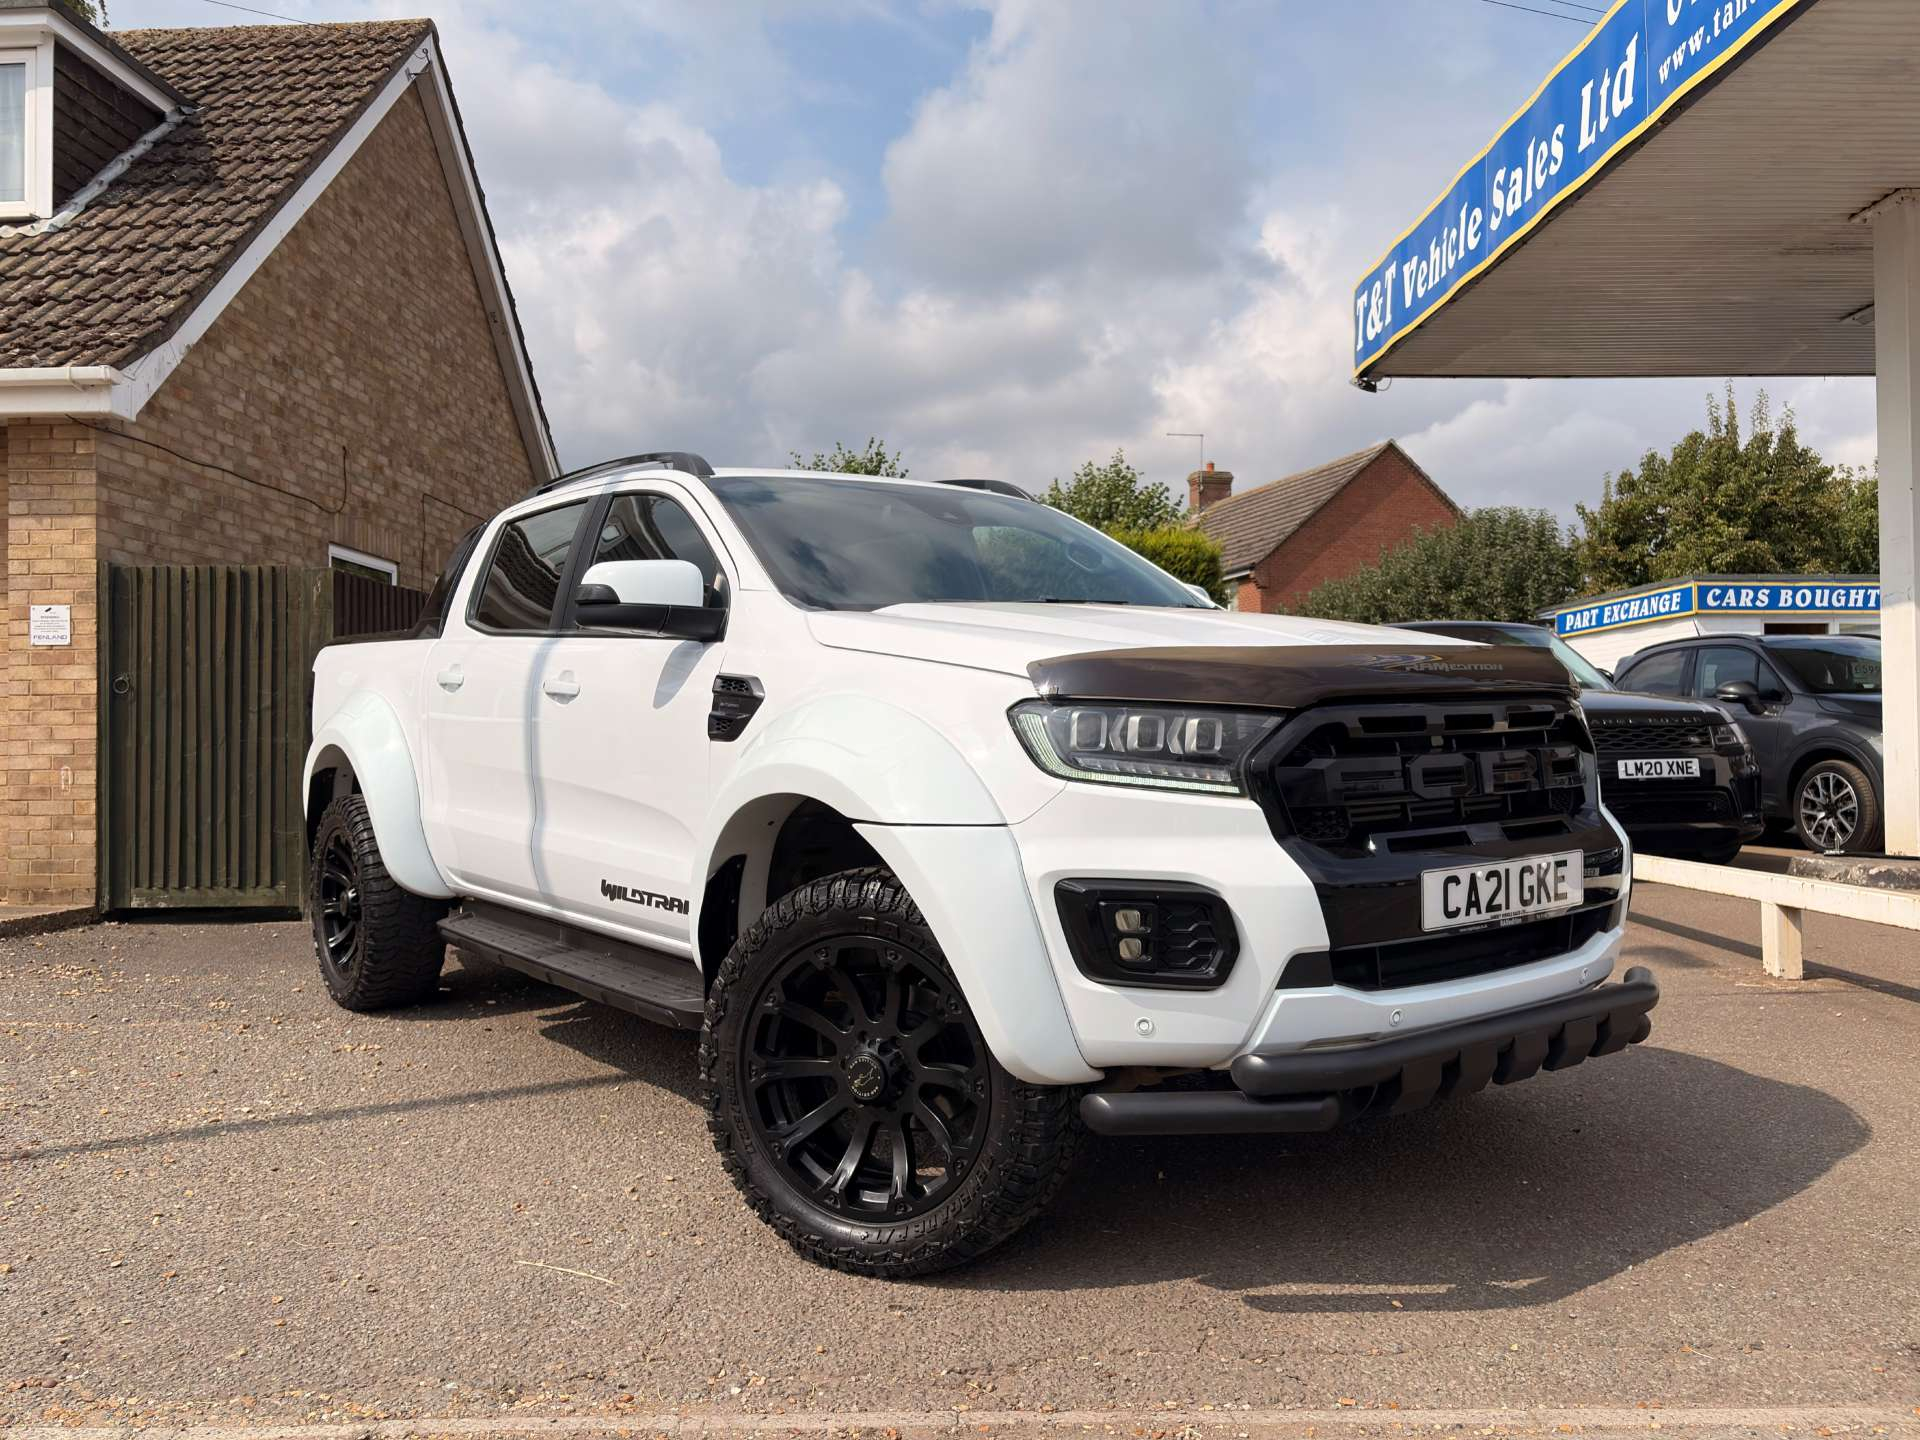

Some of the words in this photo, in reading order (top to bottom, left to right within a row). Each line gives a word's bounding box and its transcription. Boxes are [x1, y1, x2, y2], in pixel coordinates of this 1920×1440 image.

[1356, 260, 1397, 352] T&T
[1402, 201, 1483, 309] Vehicle
[1489, 123, 1565, 231] Sales
[1577, 31, 1639, 154] Ltd
[1565, 608, 1599, 631] PART
[1602, 592, 1681, 624] EXCHANGE
[1706, 588, 1771, 608] CARS
[1778, 588, 1880, 608] BOUGHT
[1624, 762, 1663, 777] LM20
[1666, 761, 1695, 776] XNE
[1442, 868, 1510, 919] CA21
[1518, 859, 1568, 907] GKE
